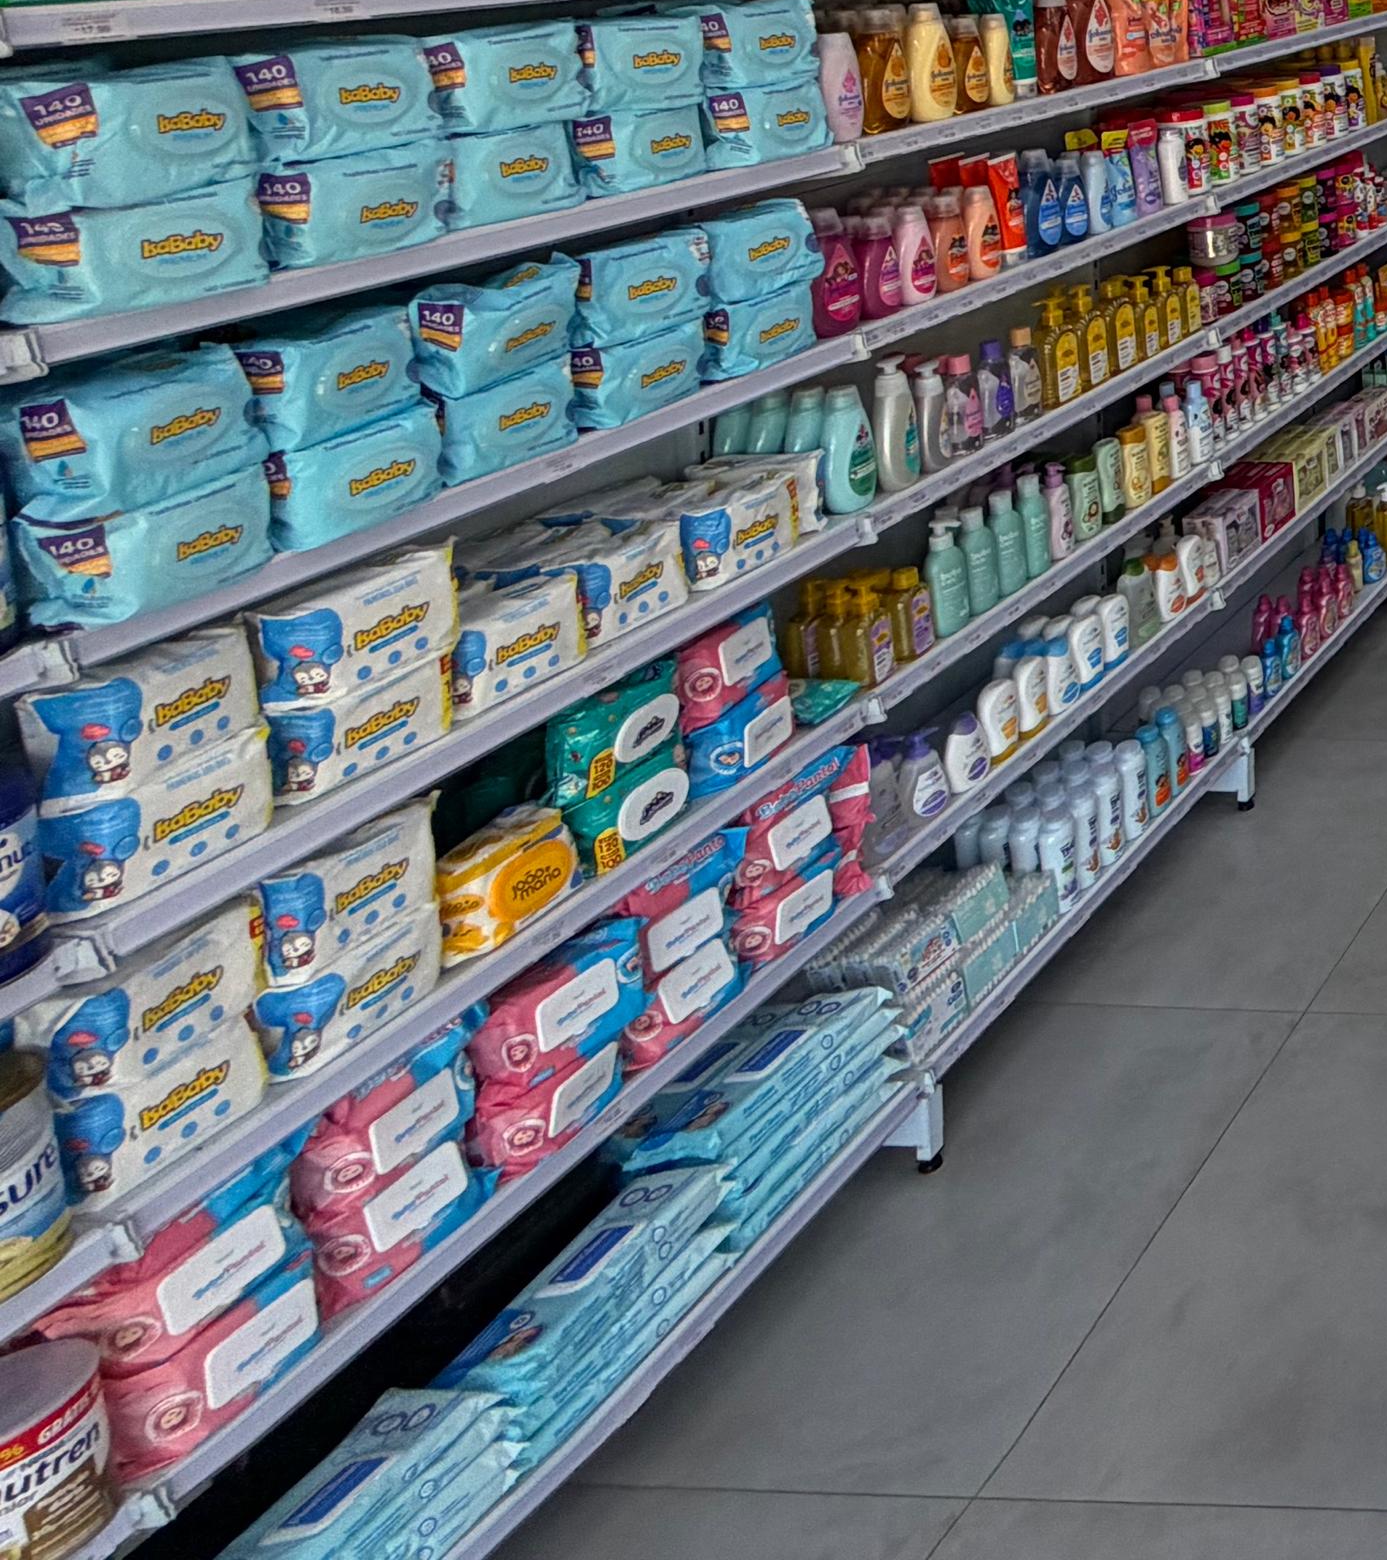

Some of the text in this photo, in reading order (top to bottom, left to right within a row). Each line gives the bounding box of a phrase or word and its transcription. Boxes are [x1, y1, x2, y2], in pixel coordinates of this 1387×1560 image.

[245, 63, 286, 83] 140
[33, 95, 83, 116] 140
[263, 181, 301, 196] 140
[141, 229, 224, 260] IsaBaby
[421, 310, 455, 326] 140
[153, 783, 245, 841] IsaBaby
[0, 1143, 59, 1217] sure
[1, 1421, 100, 1504] utren
